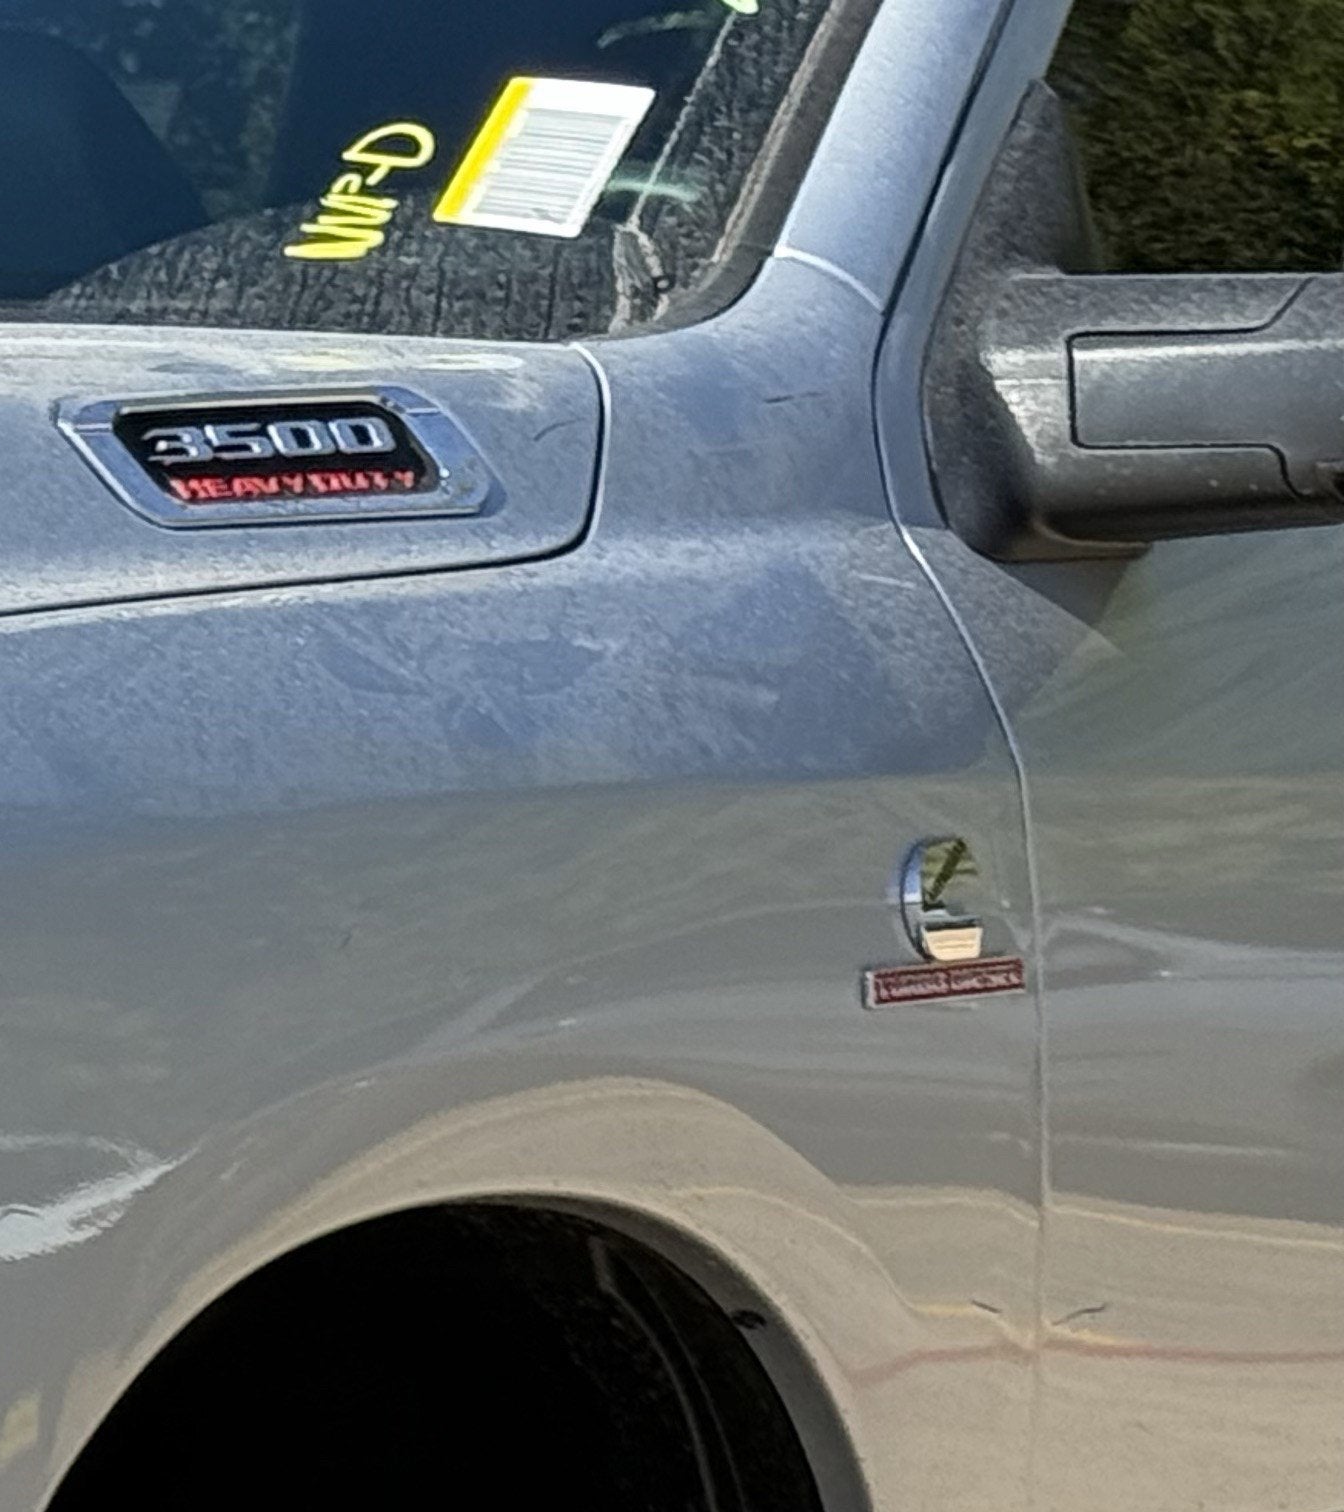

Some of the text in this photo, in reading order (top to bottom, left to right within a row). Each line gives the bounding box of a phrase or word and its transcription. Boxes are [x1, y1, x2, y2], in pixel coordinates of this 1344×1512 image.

[141, 417, 397, 465] 3500
[168, 469, 415, 501] HEAVY DUTY
